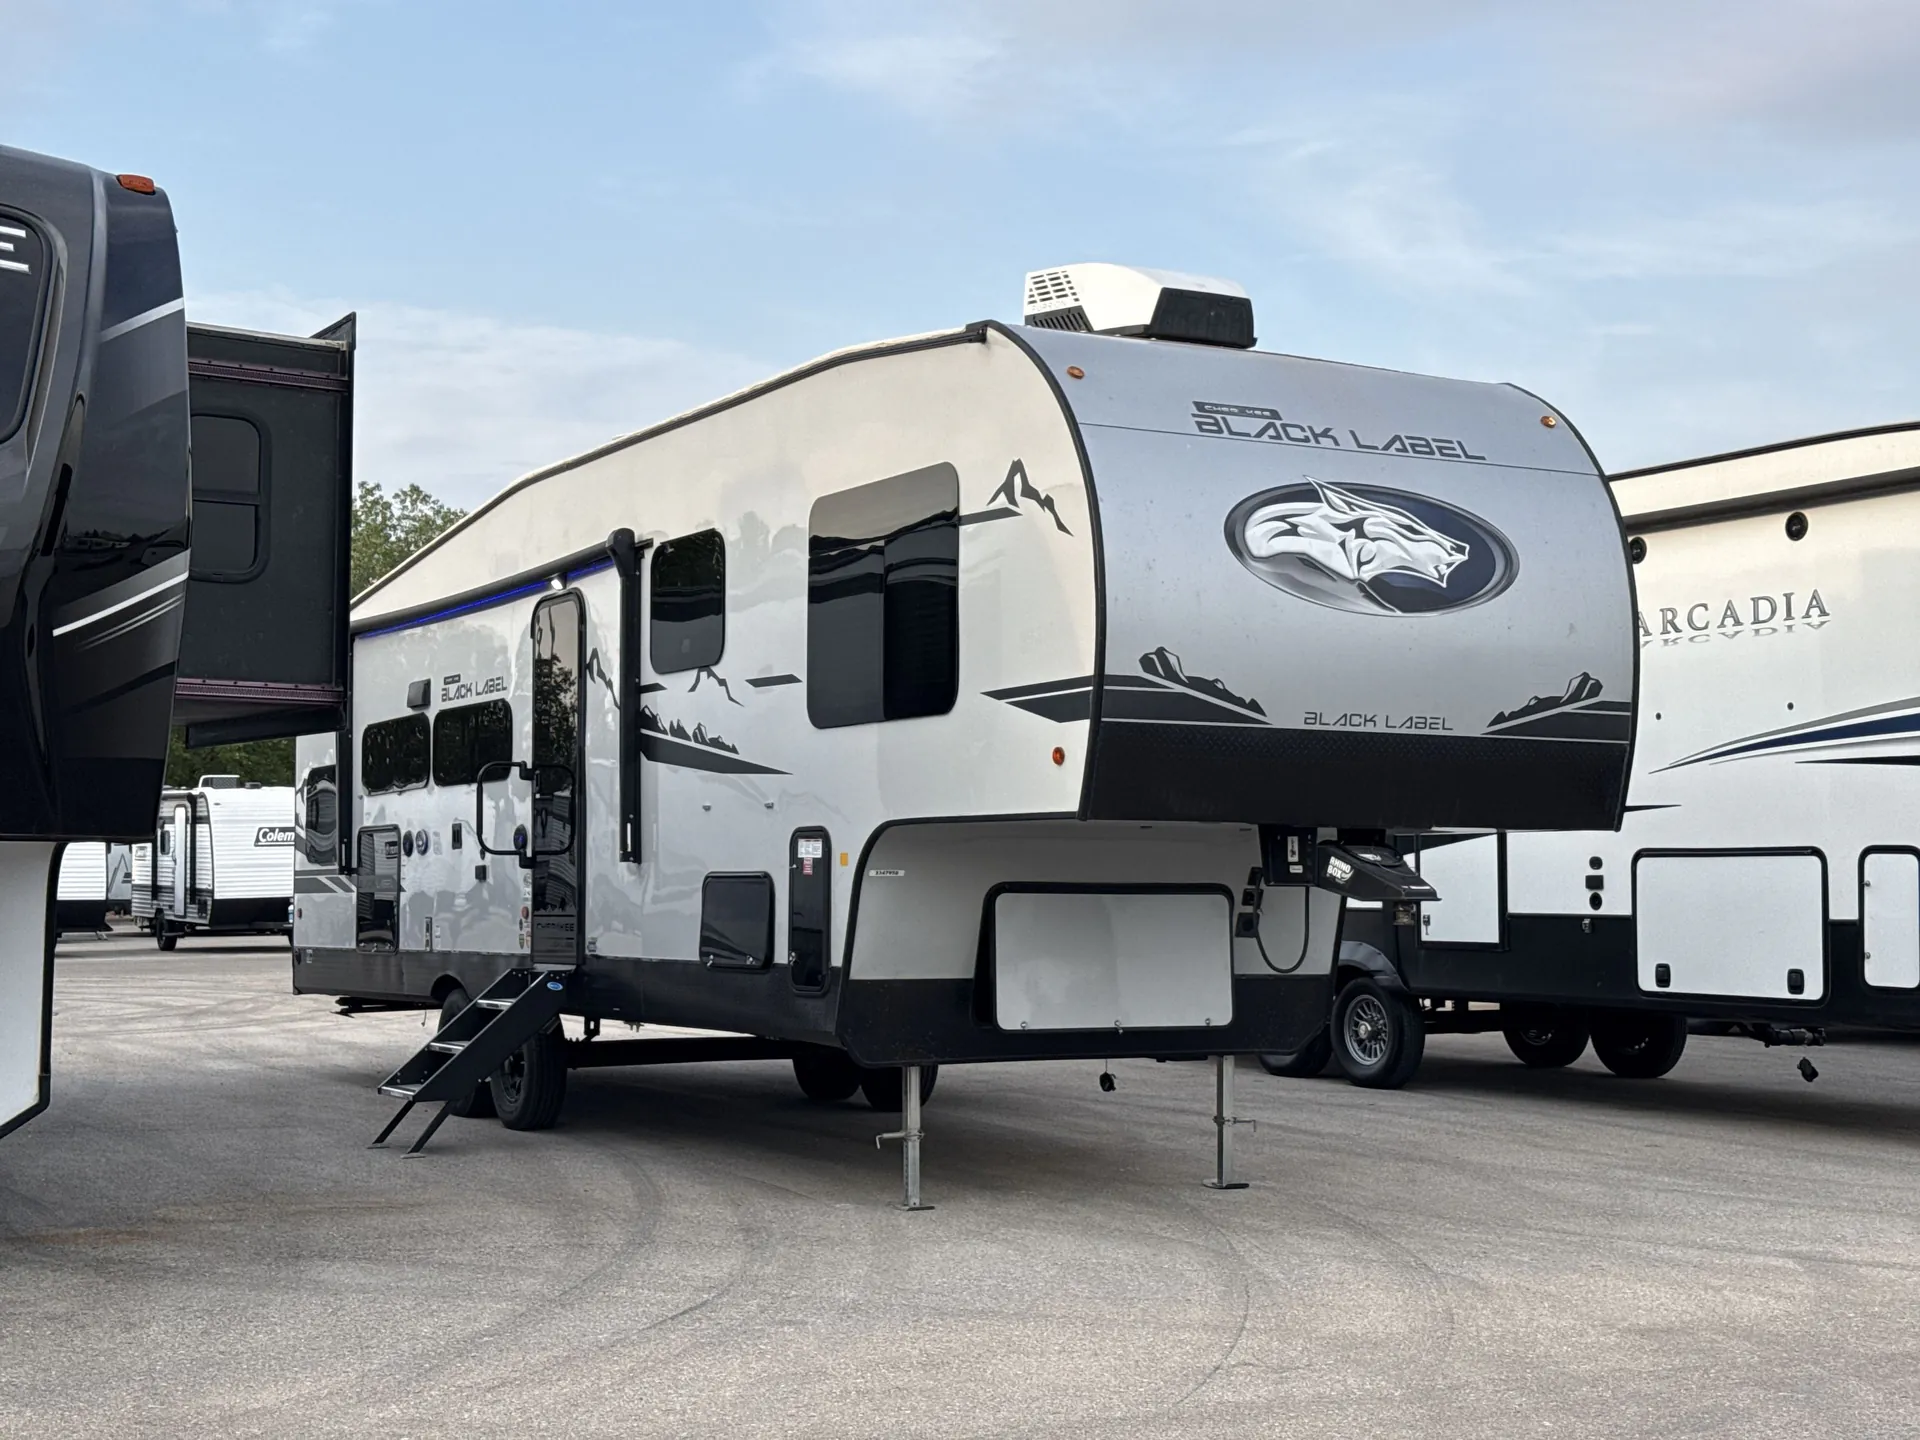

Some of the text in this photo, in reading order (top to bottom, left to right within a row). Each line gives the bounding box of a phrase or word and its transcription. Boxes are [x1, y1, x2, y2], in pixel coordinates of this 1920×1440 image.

[1203, 404, 1272, 418] CHERKEE
[1191, 412, 1487, 461] BLACK LABEL
[1637, 588, 1831, 637] ARCADIA
[441, 682, 473, 702] BLACK
[475, 675, 508, 697] LABEL
[1303, 711, 1454, 731] BLACK LABEL
[258, 827, 296, 843] Colem
[1327, 864, 1343, 879] BOX
[1329, 855, 1352, 874] RHINO
